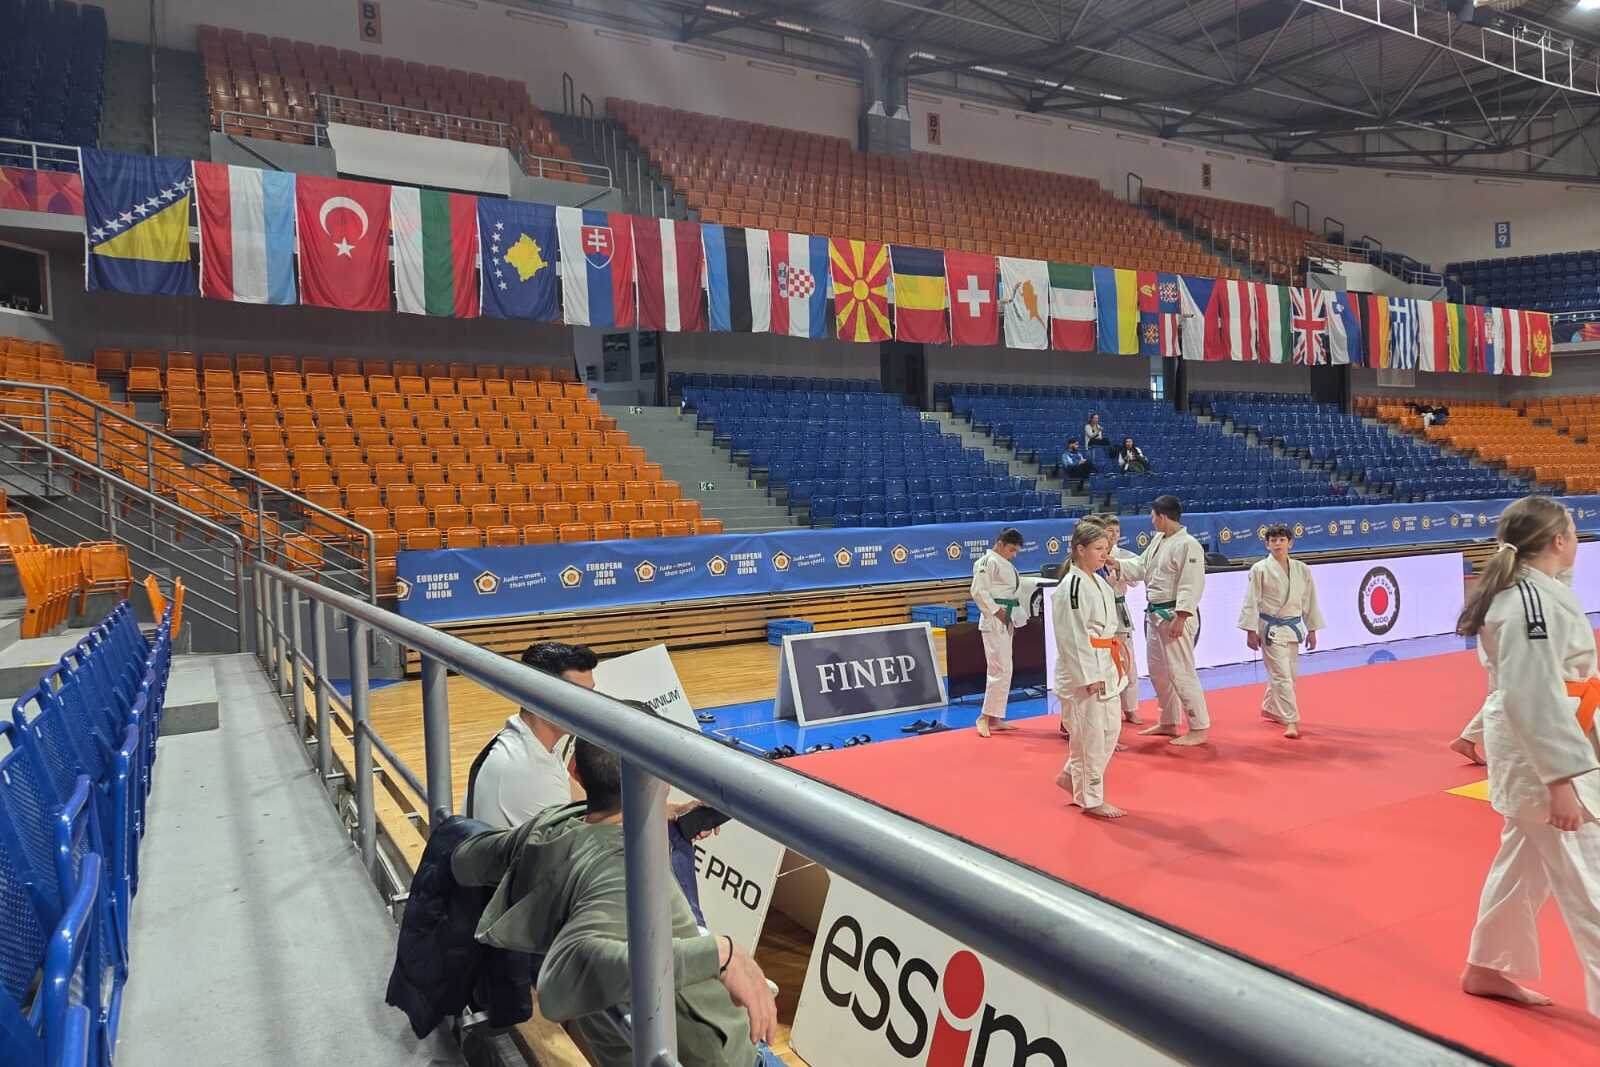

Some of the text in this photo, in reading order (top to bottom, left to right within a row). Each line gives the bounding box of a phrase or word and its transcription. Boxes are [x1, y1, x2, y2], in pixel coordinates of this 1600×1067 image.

[363, 3, 377, 37] B 6
[931, 129, 937, 141] 7
[1498, 224, 1507, 246] B 9
[730, 552, 762, 561] EUROPEAN
[586, 562, 623, 571] EUROPEAN
[738, 559, 755, 568] JUDO
[595, 570, 614, 578] JUDO
[737, 567, 758, 575] UNION
[416, 572, 459, 583] EUROPEAN
[593, 577, 617, 586] UNION
[428, 581, 449, 591] JUDO
[425, 590, 452, 600] UNION
[1374, 616, 1388, 624] JUDO
[816, 655, 917, 695] FINEP
[705, 855, 762, 911] PRO
